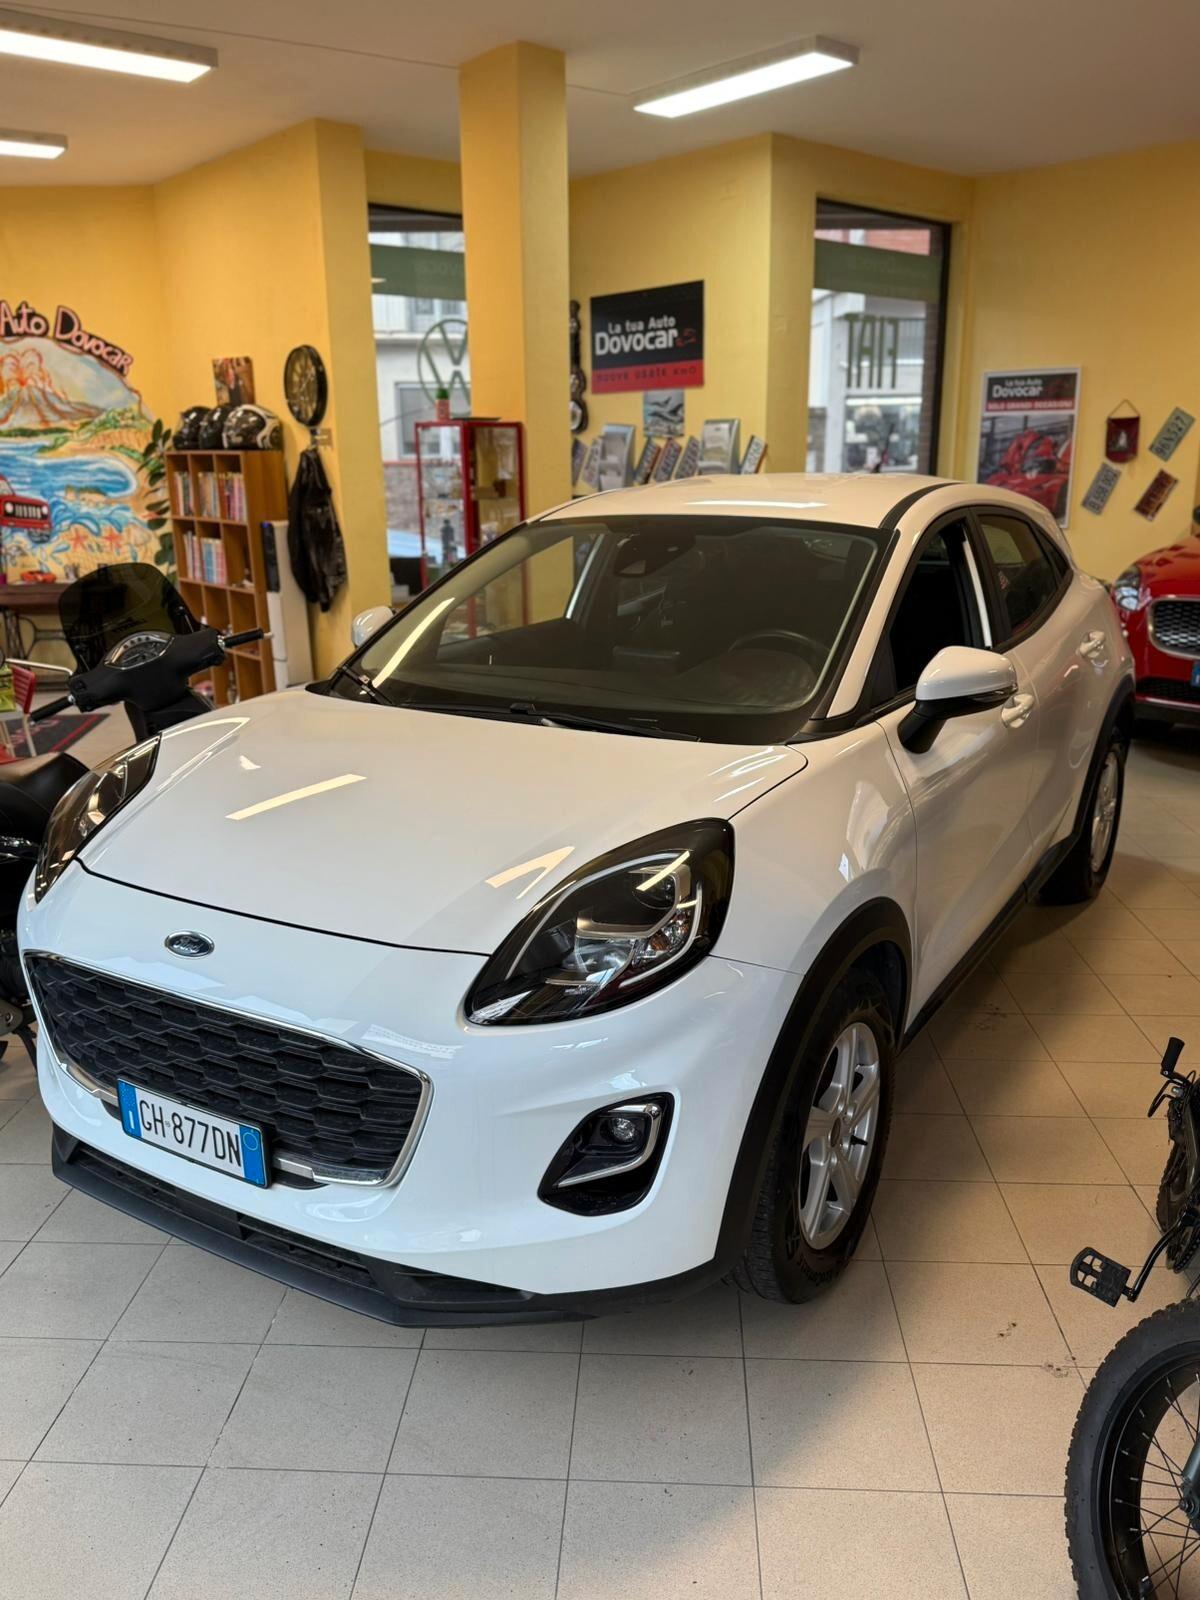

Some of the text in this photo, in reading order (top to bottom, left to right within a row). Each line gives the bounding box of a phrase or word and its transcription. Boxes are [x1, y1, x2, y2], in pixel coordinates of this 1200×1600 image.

[0, 301, 46, 335] Auto
[608, 315, 676, 335] La tua Auto
[595, 328, 678, 356] Dovocar
[992, 384, 1043, 398] Dovocar
[172, 935, 203, 953] Ford
